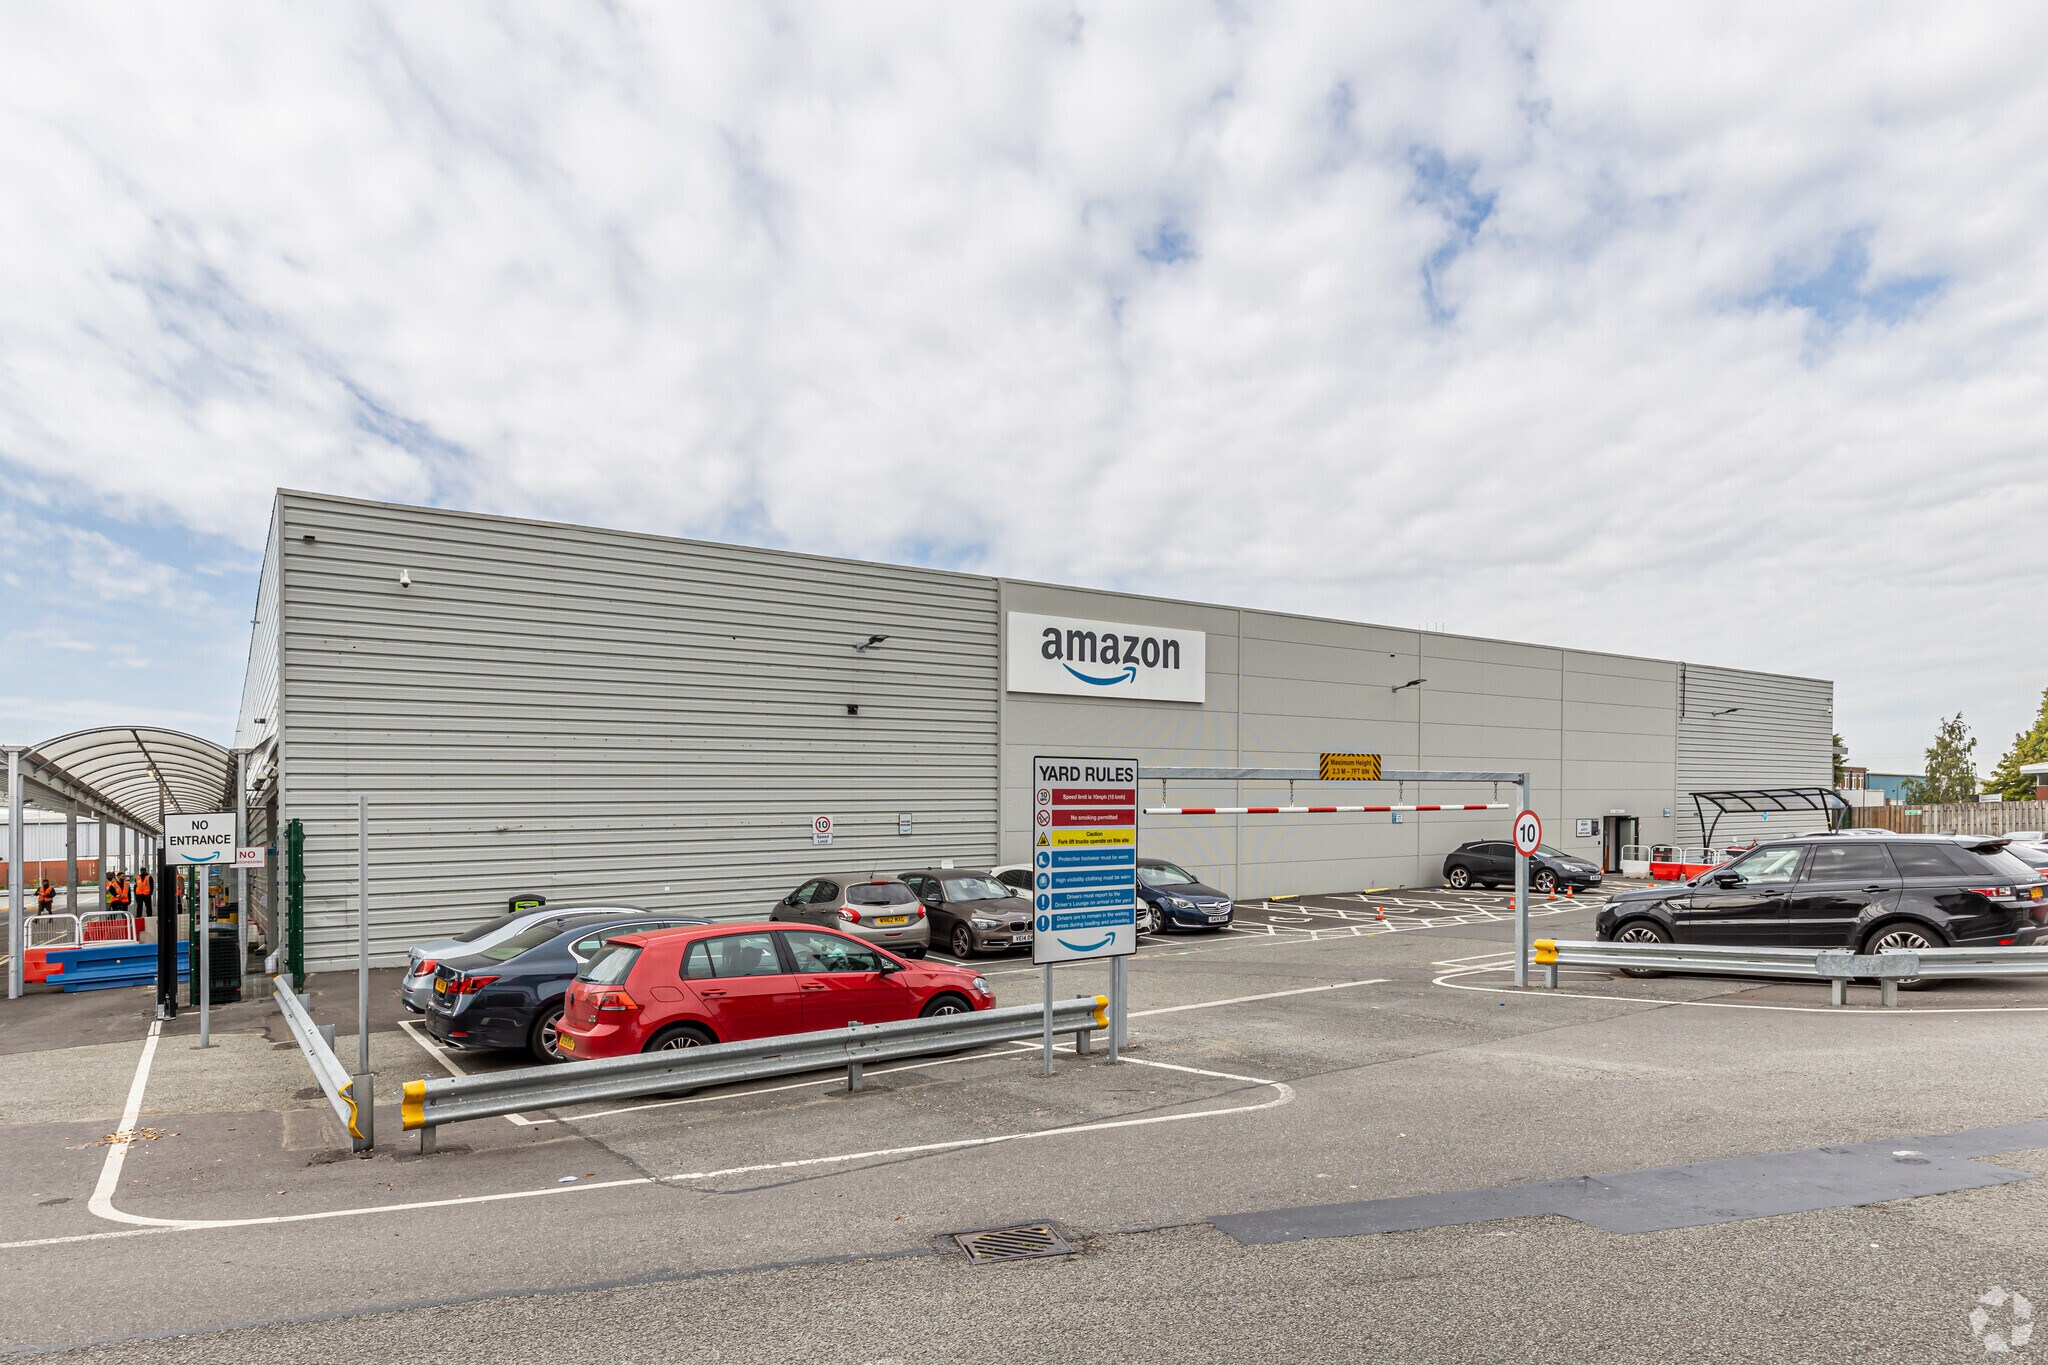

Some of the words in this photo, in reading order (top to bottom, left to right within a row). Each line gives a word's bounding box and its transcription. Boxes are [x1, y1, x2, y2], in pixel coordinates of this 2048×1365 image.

[1041, 627, 1180, 670] amazon
[1039, 766, 1080, 781] YARD
[1085, 767, 1134, 782] RULES
[192, 820, 208, 830] NO
[1520, 824, 1535, 842] 10
[170, 834, 231, 845] ENTRANCE
